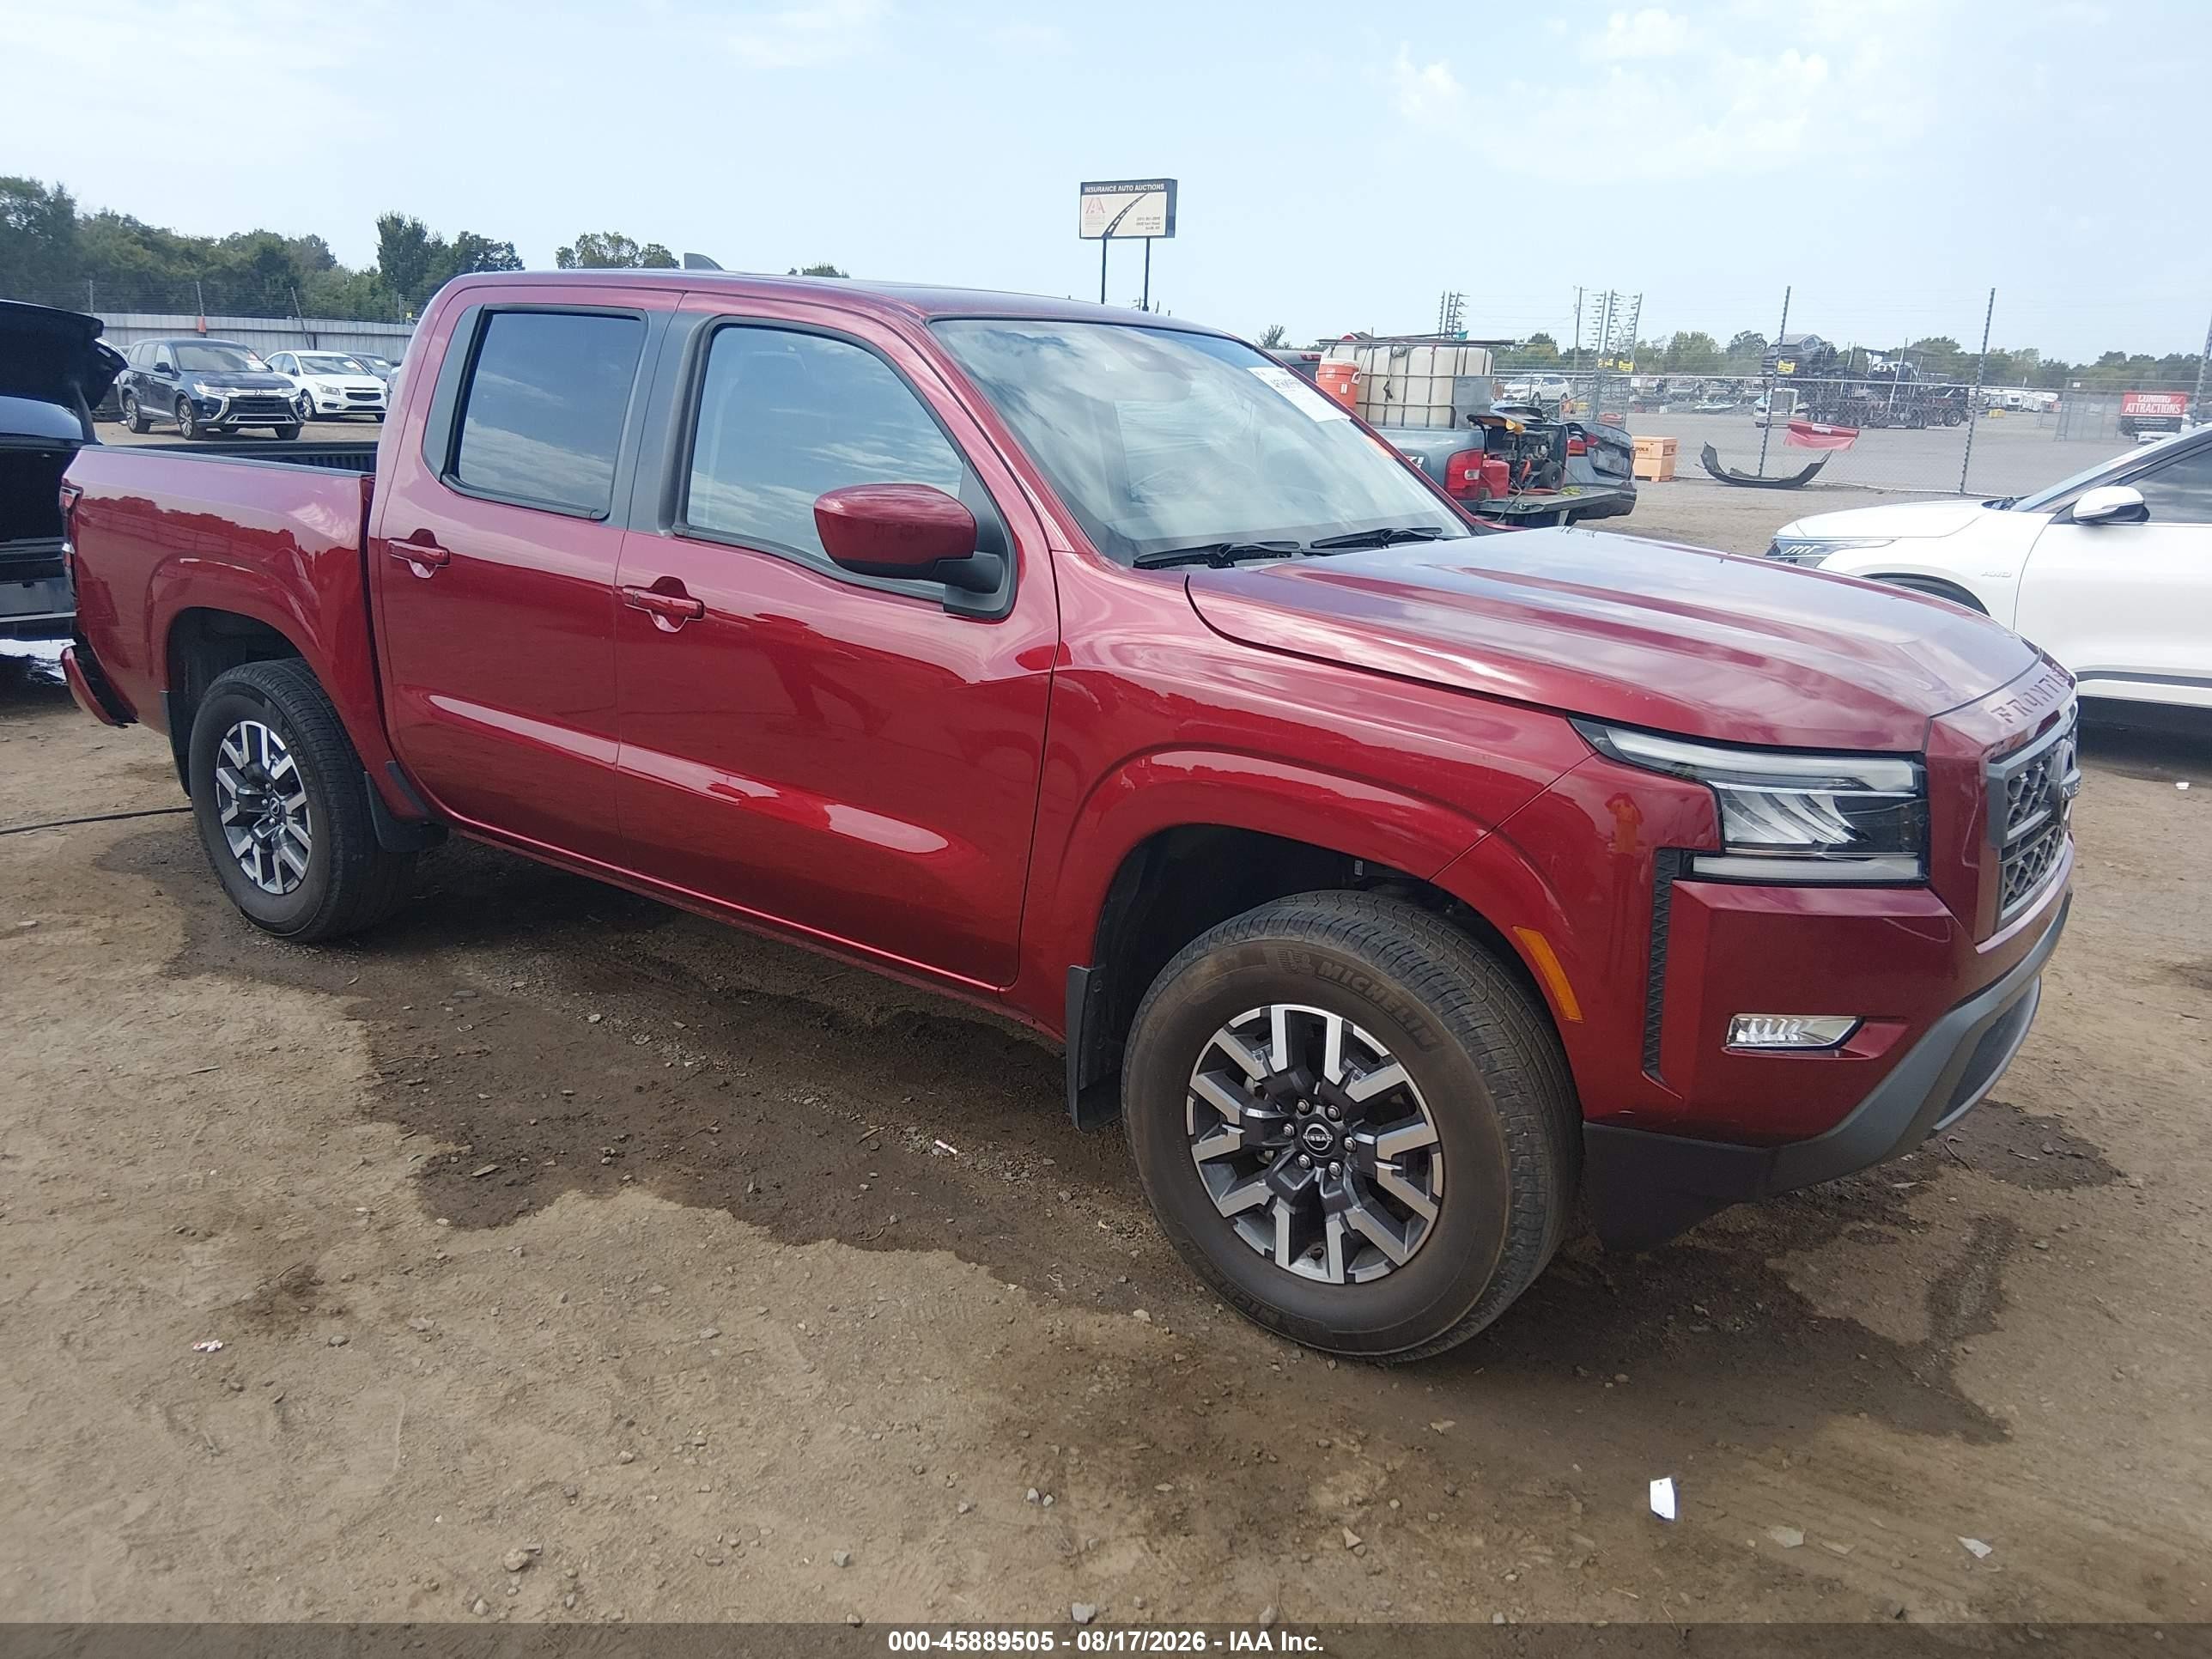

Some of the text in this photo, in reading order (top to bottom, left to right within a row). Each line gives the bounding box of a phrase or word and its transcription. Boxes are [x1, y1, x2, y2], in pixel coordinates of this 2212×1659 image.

[2124, 403, 2182, 414] ATTRACTIONS
[1317, 960, 1438, 1047] MICHELIN
[1302, 1133, 1334, 1142] NISSAN
